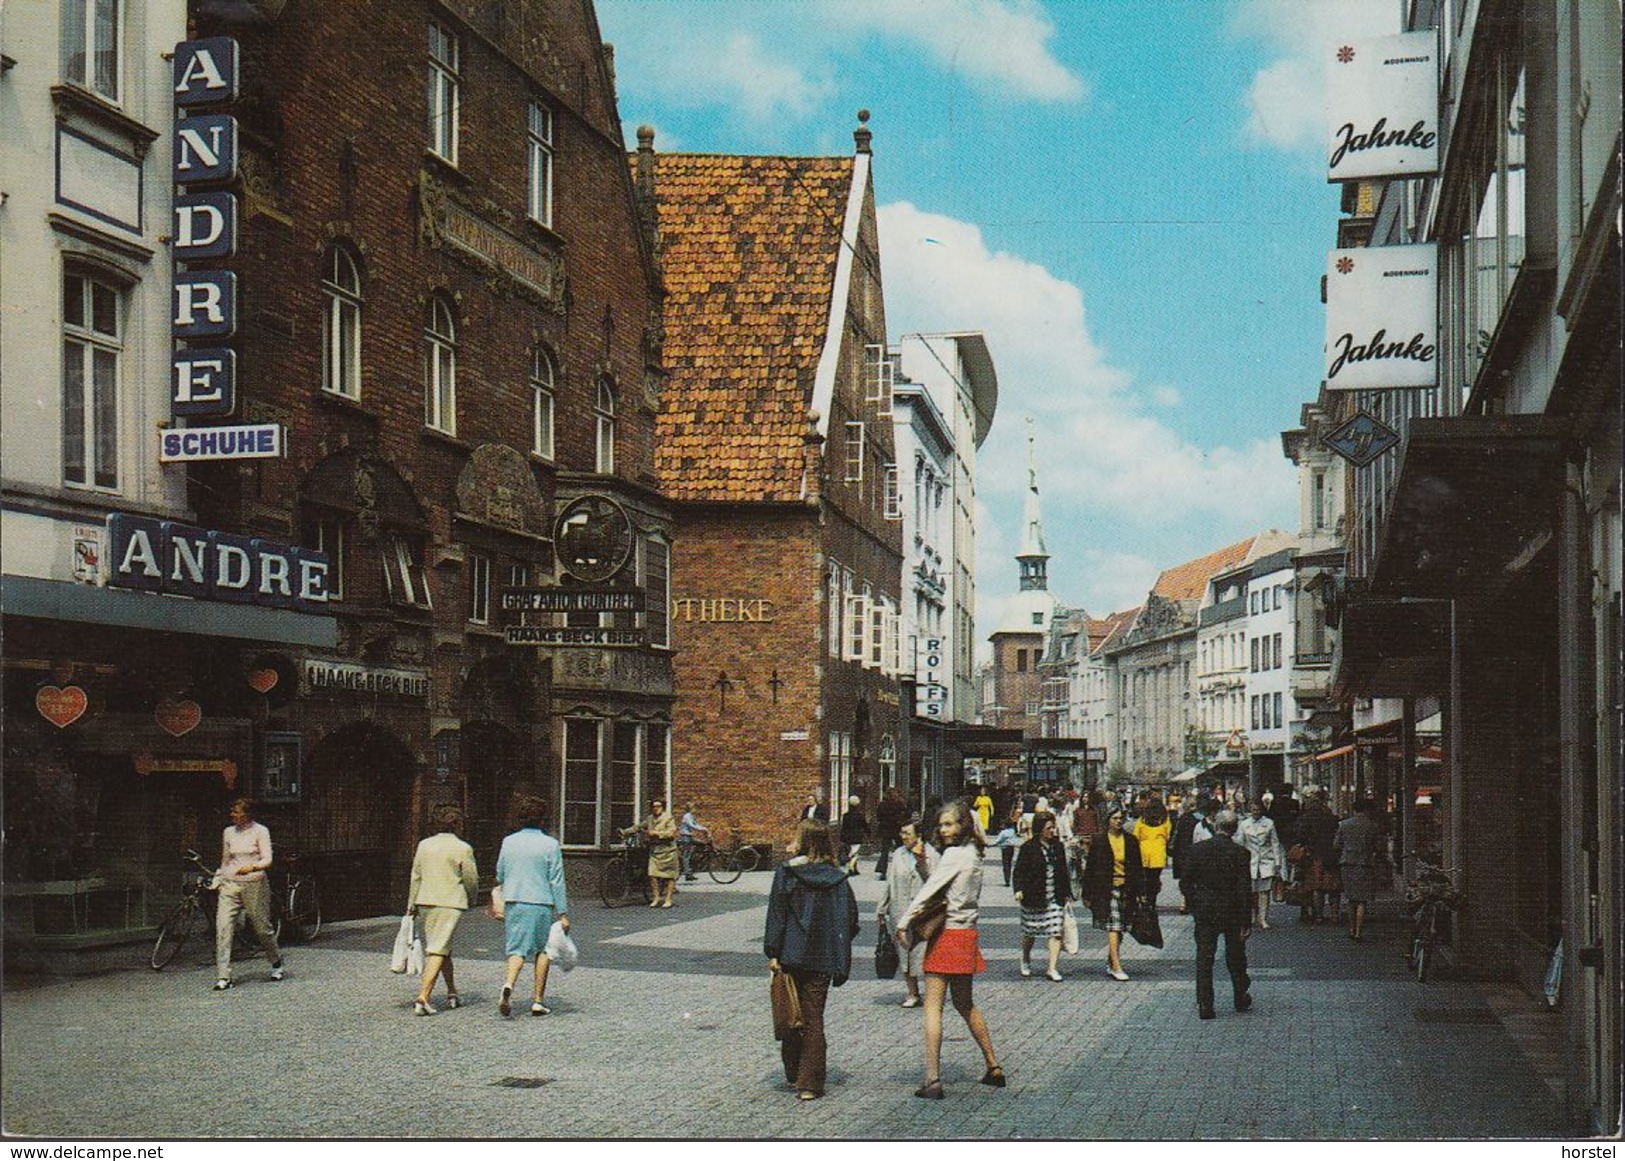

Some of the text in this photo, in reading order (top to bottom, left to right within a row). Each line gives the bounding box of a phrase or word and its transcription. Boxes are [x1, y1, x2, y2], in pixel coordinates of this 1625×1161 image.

[1329, 117, 1436, 168] Jahnke
[174, 49, 227, 402] ANDRE
[1328, 329, 1435, 379] Jahnke
[164, 429, 275, 456] SCHUHE
[118, 530, 329, 602] ANDRE
[927, 639, 940, 715] ROLFS
